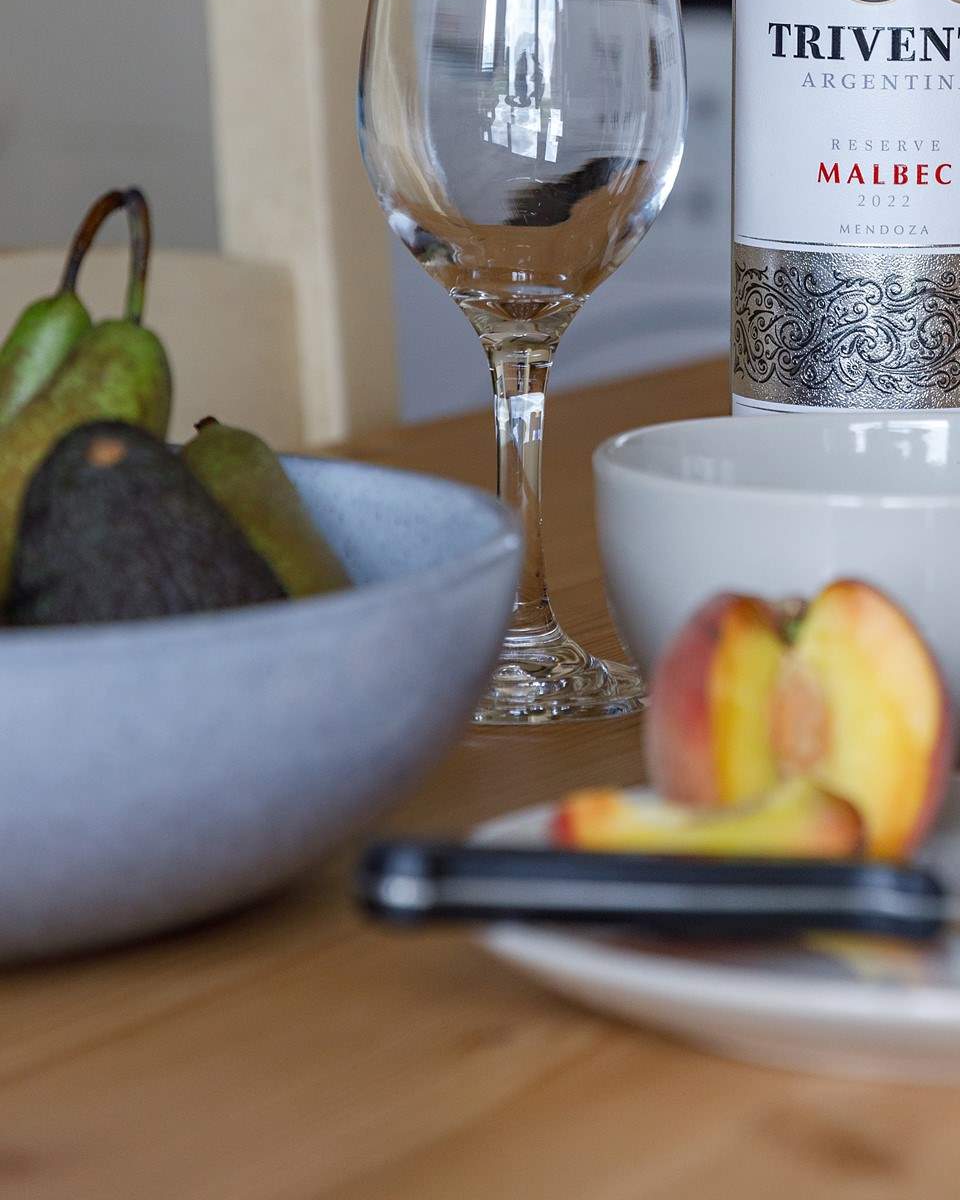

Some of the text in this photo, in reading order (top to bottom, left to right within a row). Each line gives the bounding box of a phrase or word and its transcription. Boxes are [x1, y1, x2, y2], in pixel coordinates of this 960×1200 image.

[831, 139, 941, 152] RESERVE
[817, 162, 952, 185] MALBEC
[858, 194, 911, 208] 2022
[840, 224, 929, 236] MENDOZA
